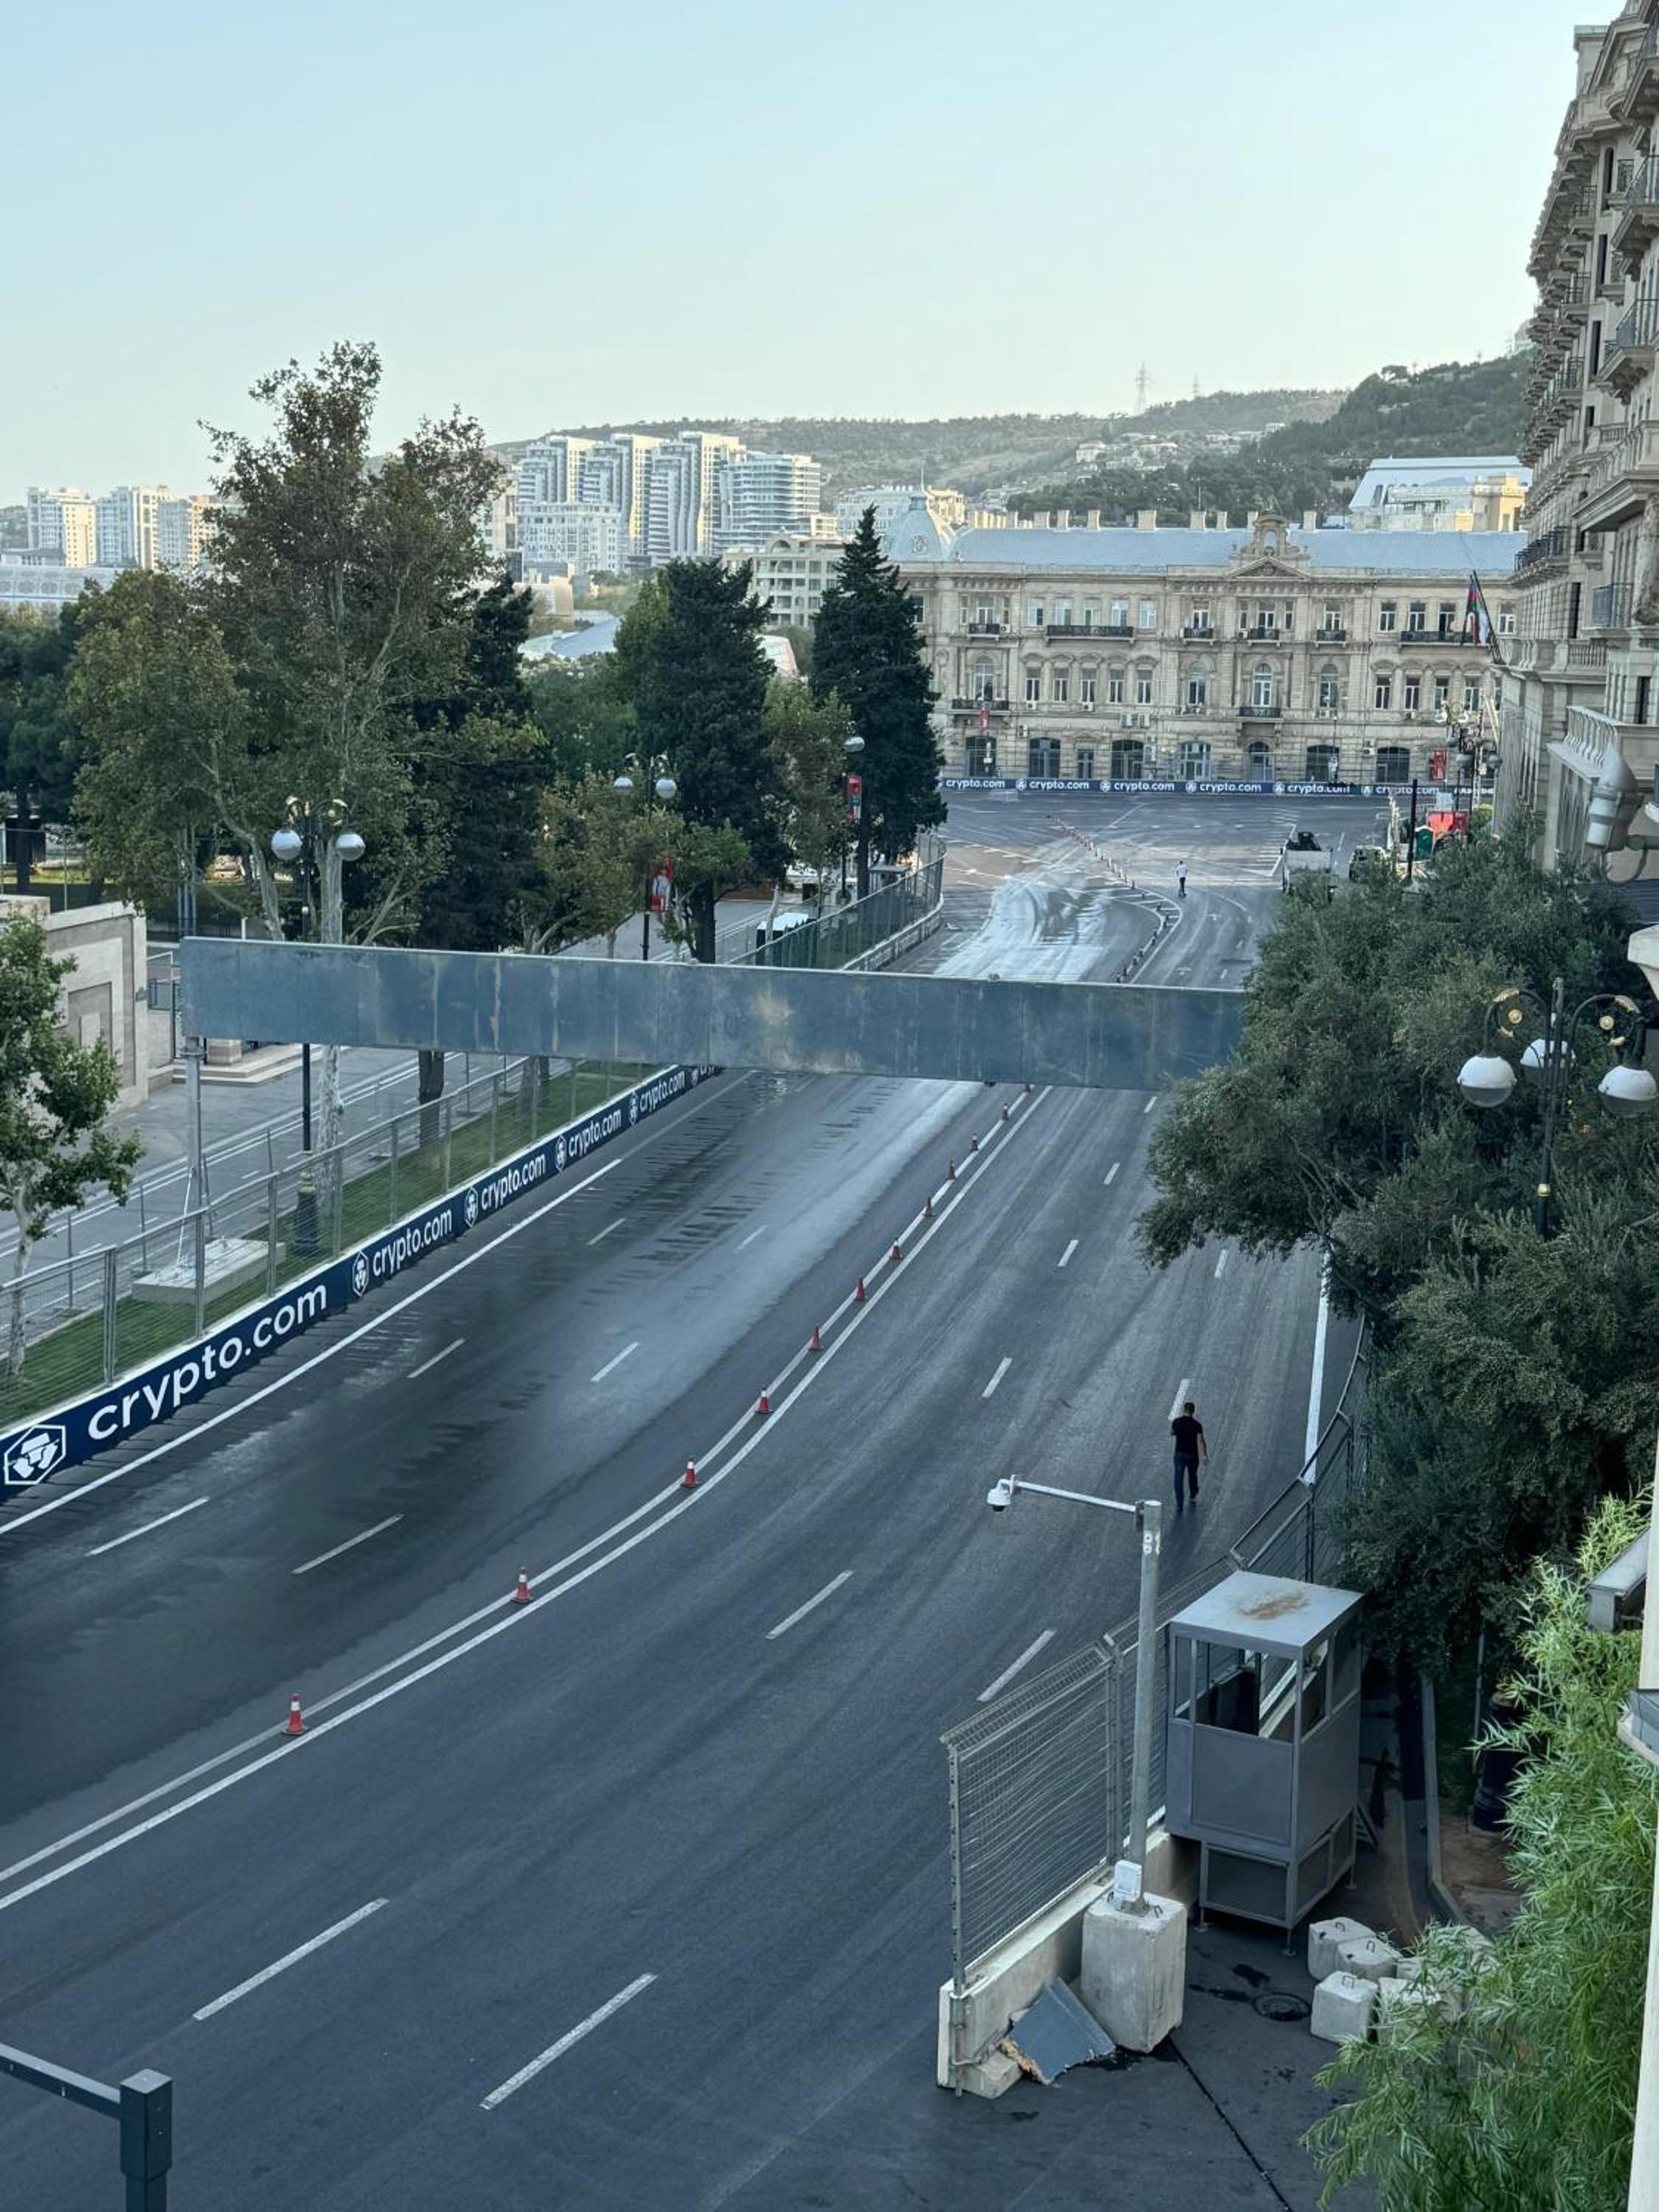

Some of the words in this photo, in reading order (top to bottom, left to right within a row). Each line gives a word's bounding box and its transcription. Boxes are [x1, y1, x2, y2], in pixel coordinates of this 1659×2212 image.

[945, 779, 1006, 789] crypto.com
[1029, 779, 1090, 790] crypto.com
[1114, 780, 1175, 791] crypto.com
[1200, 782, 1262, 793] crypto.com
[639, 1070, 686, 1112] crypto.com
[568, 1109, 622, 1158] crypto.com
[481, 1152, 546, 1211] crypto.com
[372, 1208, 453, 1276] crypto.com
[87, 1284, 327, 1441] crypto.com
